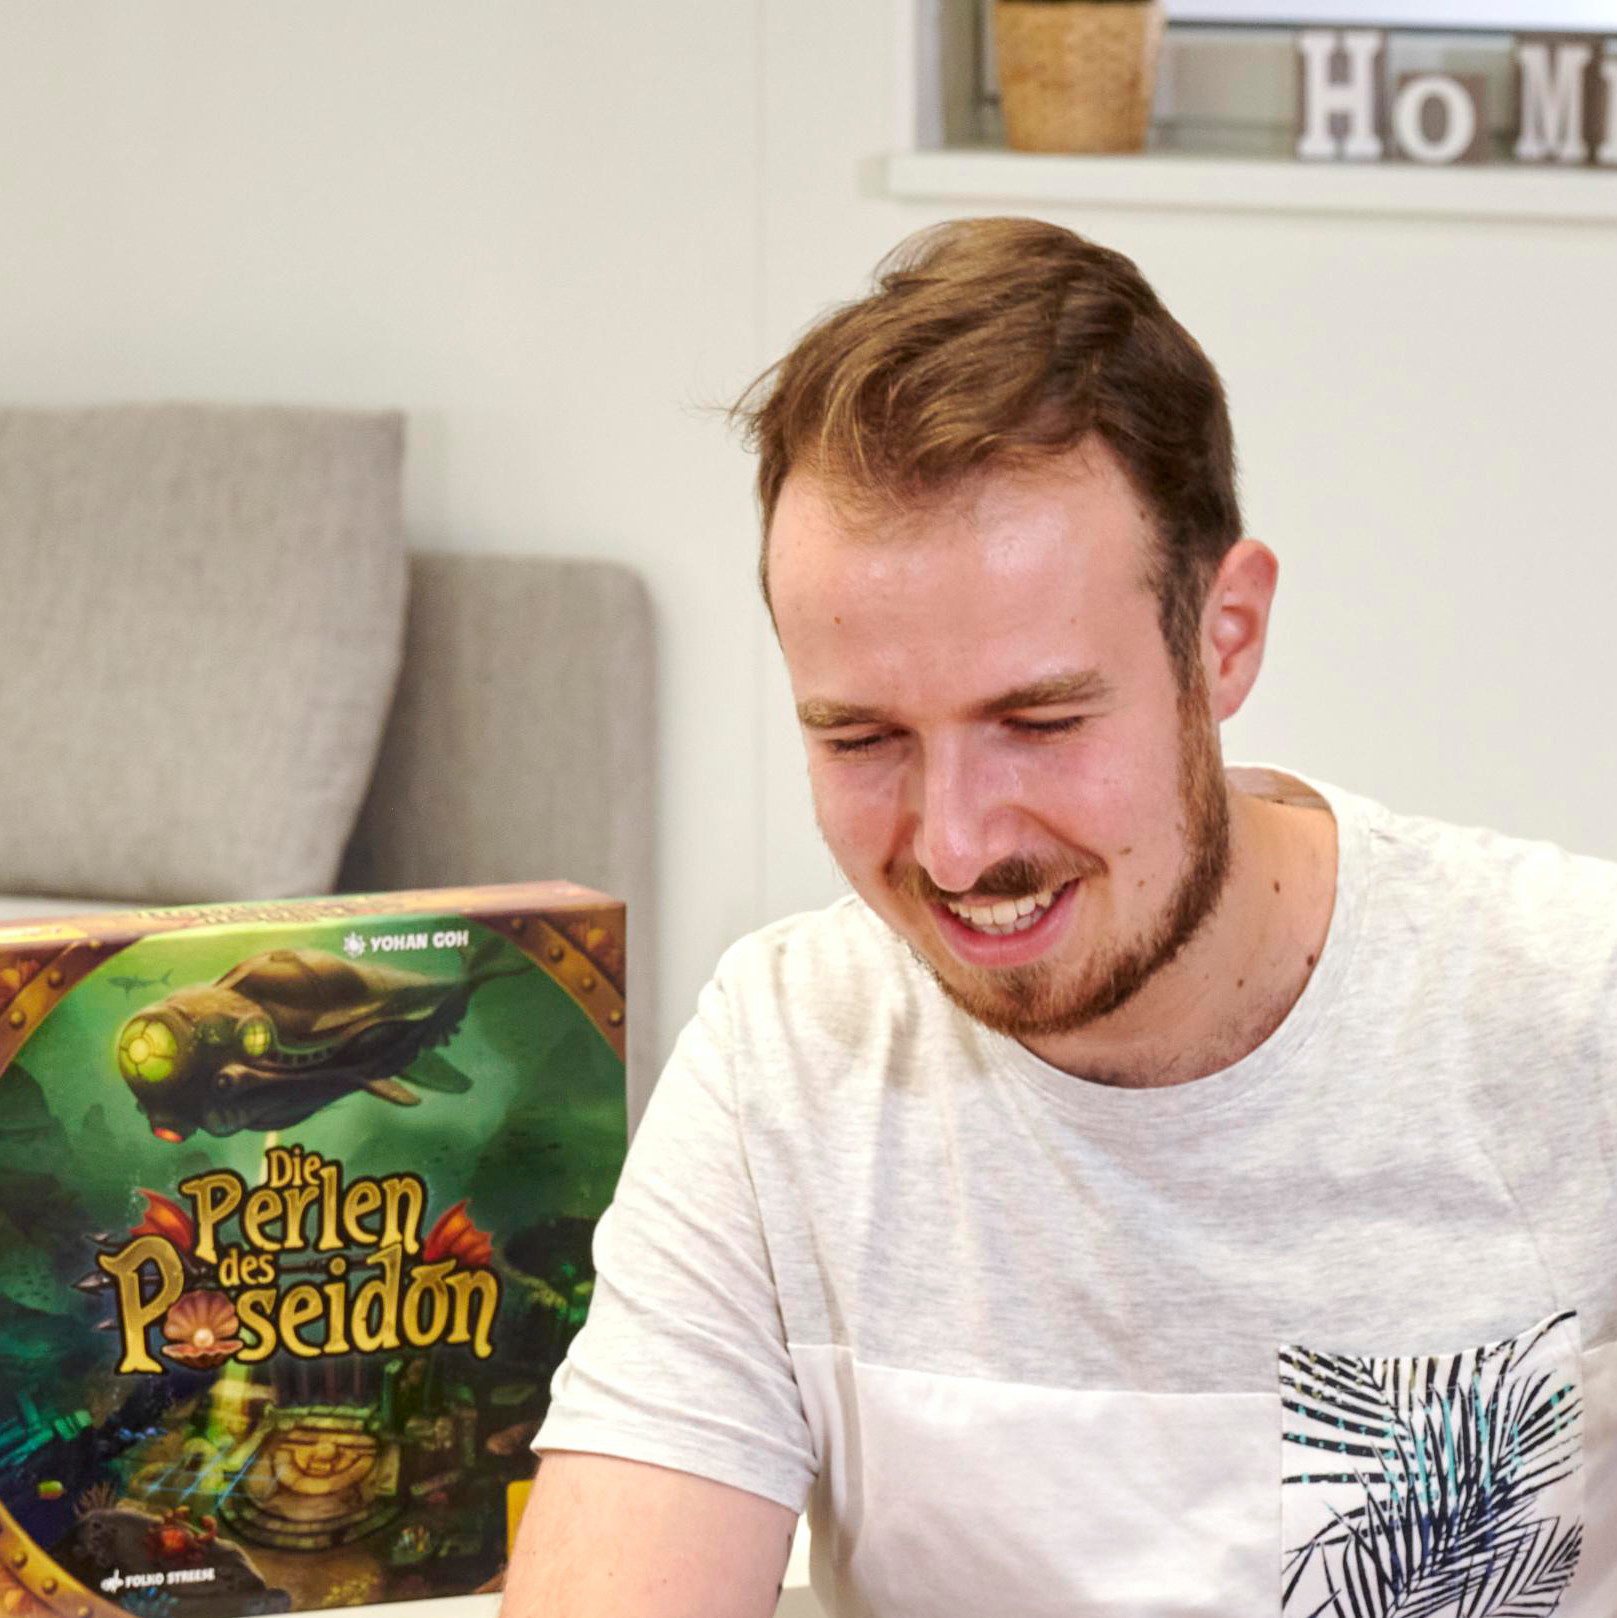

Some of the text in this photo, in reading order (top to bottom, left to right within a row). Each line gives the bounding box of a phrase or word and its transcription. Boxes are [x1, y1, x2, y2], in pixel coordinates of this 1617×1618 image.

[370, 933, 428, 952] YOHAN
[268, 1146, 320, 1188] Die
[180, 1165, 425, 1264] Perlen
[218, 1247, 276, 1287] des
[124, 1572, 165, 1588] FOLKO
